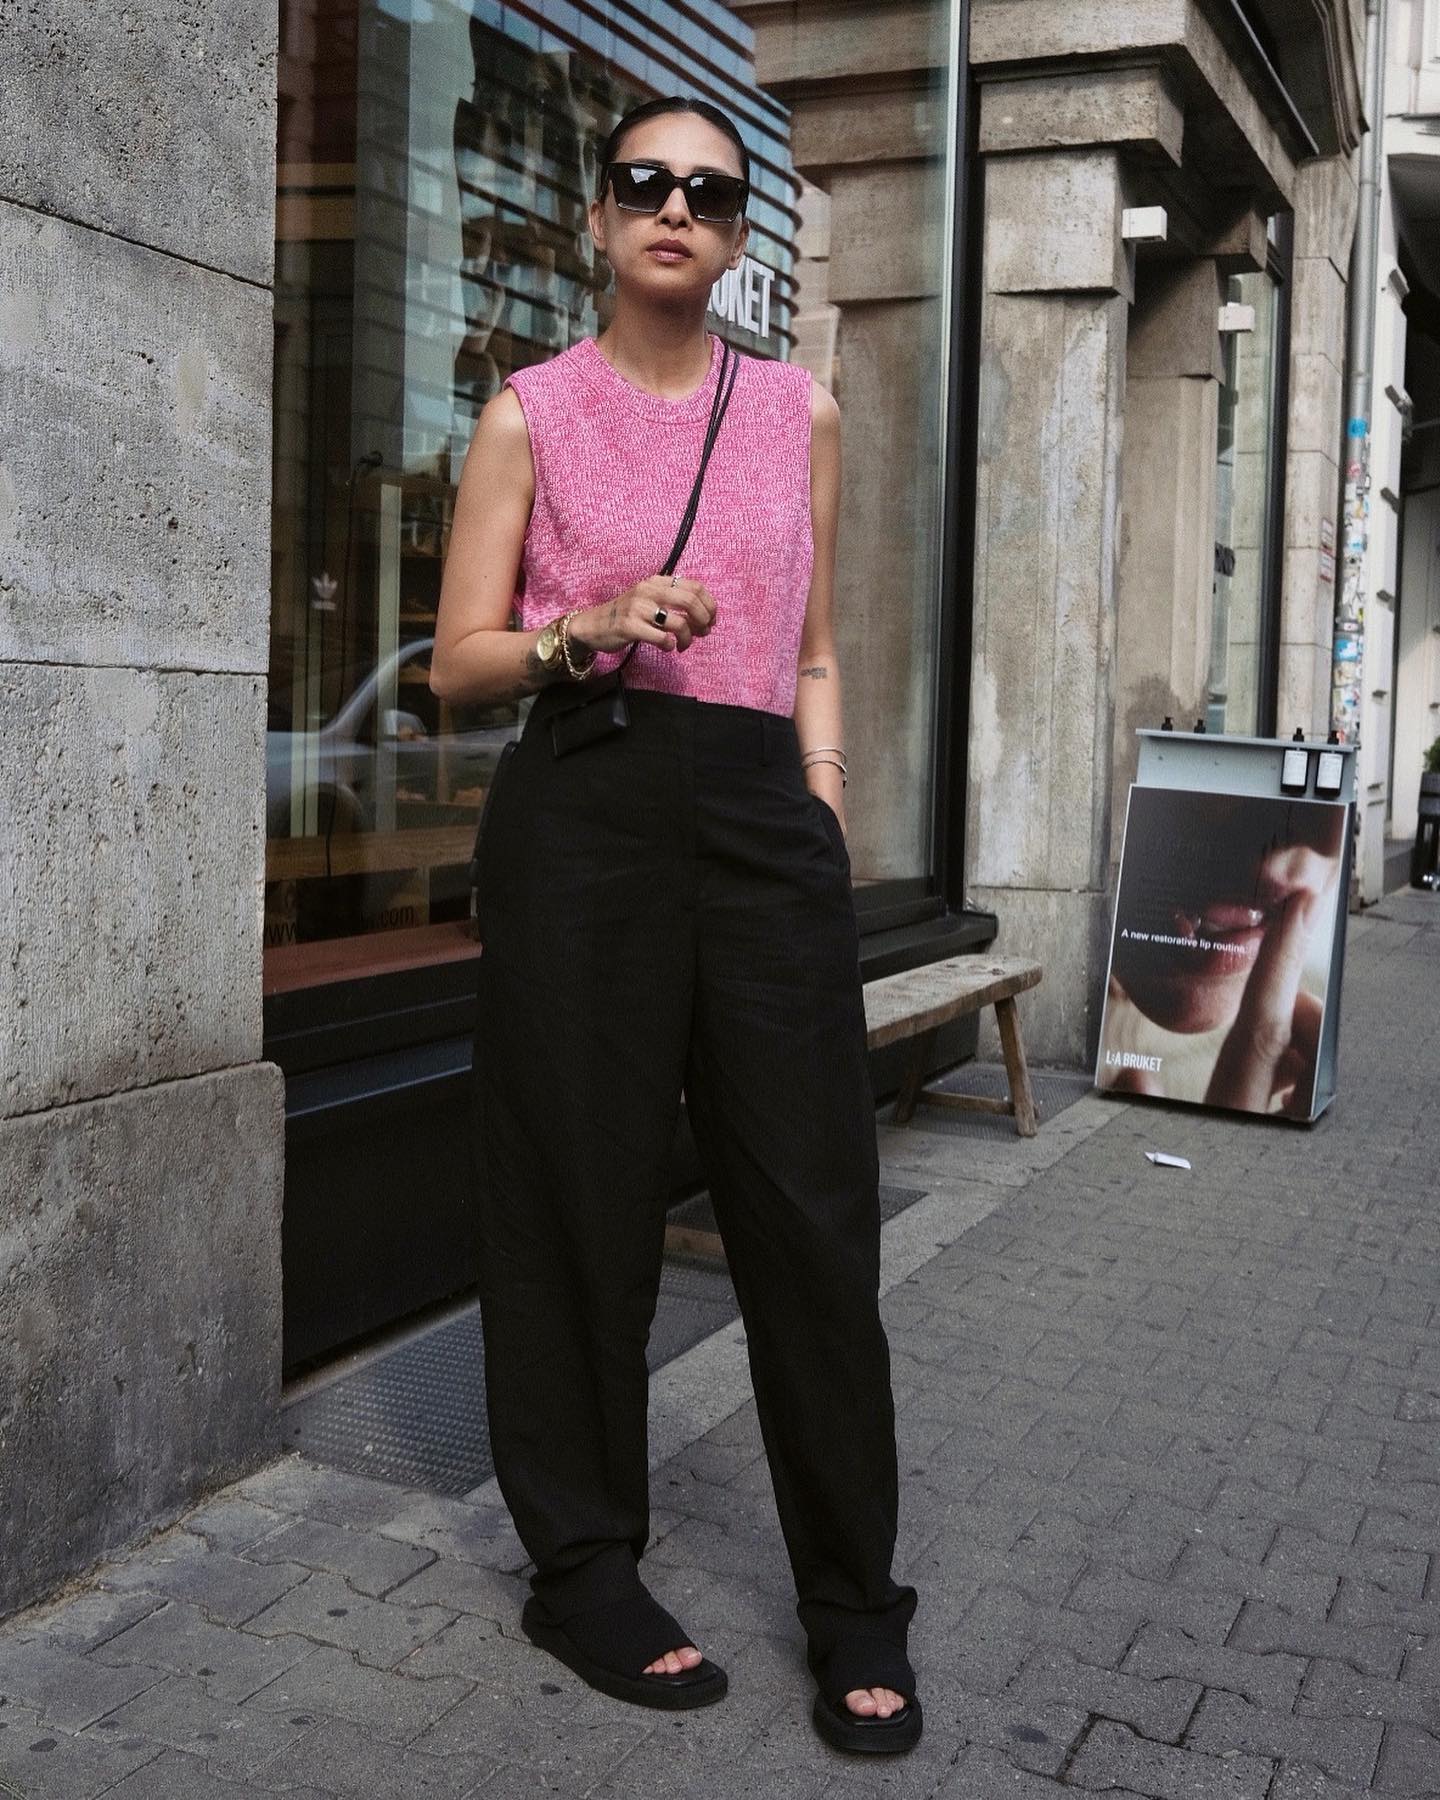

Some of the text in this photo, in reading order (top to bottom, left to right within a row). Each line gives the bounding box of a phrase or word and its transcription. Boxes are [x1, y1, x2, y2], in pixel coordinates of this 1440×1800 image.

[706, 254, 775, 338] UKET
[1121, 928, 1129, 938] A
[1131, 932, 1149, 940] new
[1151, 935, 1198, 947] restorative
[1200, 938, 1211, 951] lip
[1123, 1052, 1163, 1073] BRUKET
